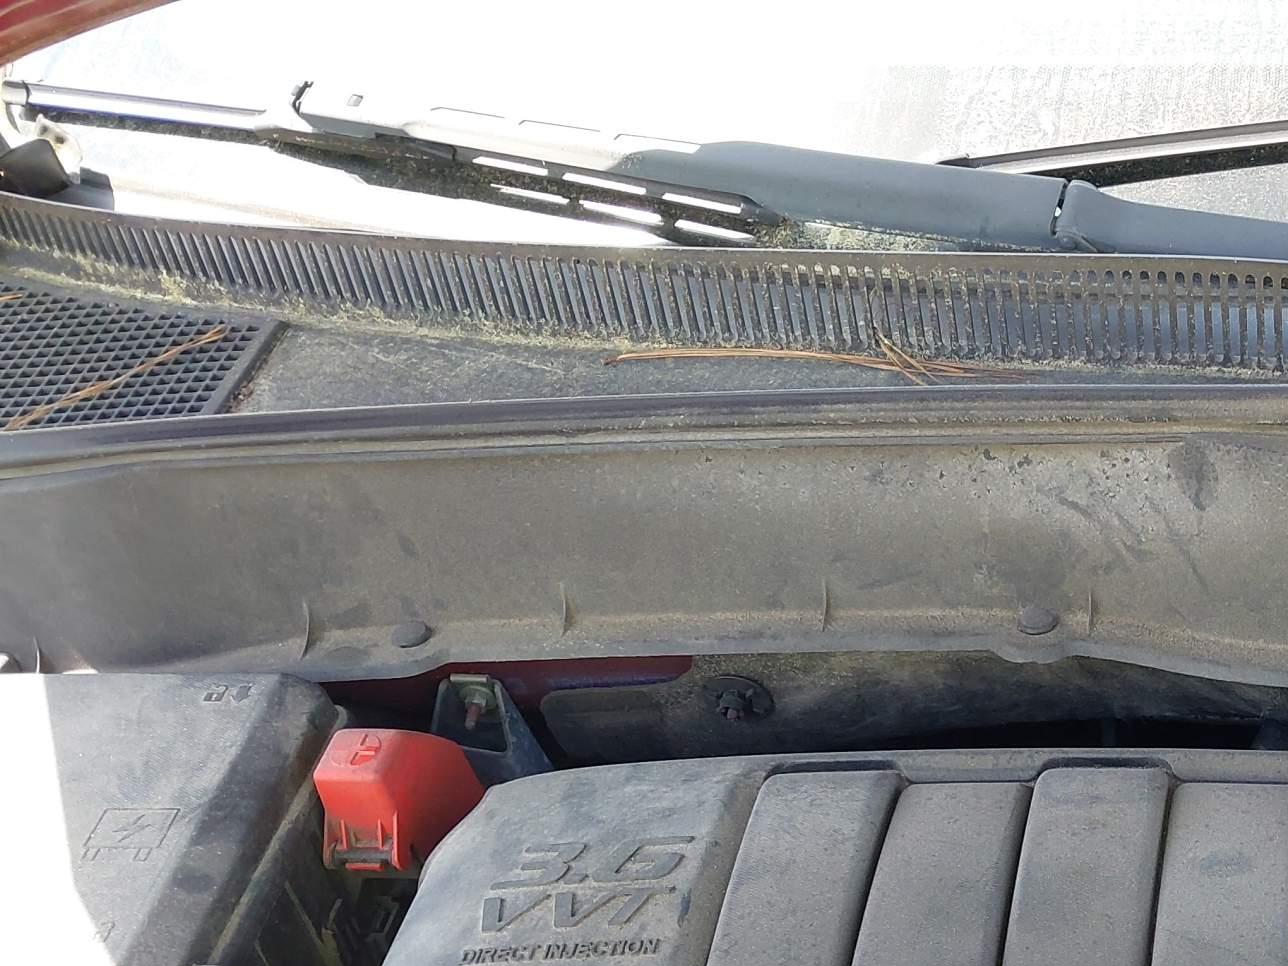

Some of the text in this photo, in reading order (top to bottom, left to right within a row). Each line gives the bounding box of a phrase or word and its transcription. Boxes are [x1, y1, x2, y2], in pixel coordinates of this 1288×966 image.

[490, 835, 696, 891] 3.6
[481, 886, 677, 933] VVT
[459, 938, 662, 966] DIRECT INJECTION
